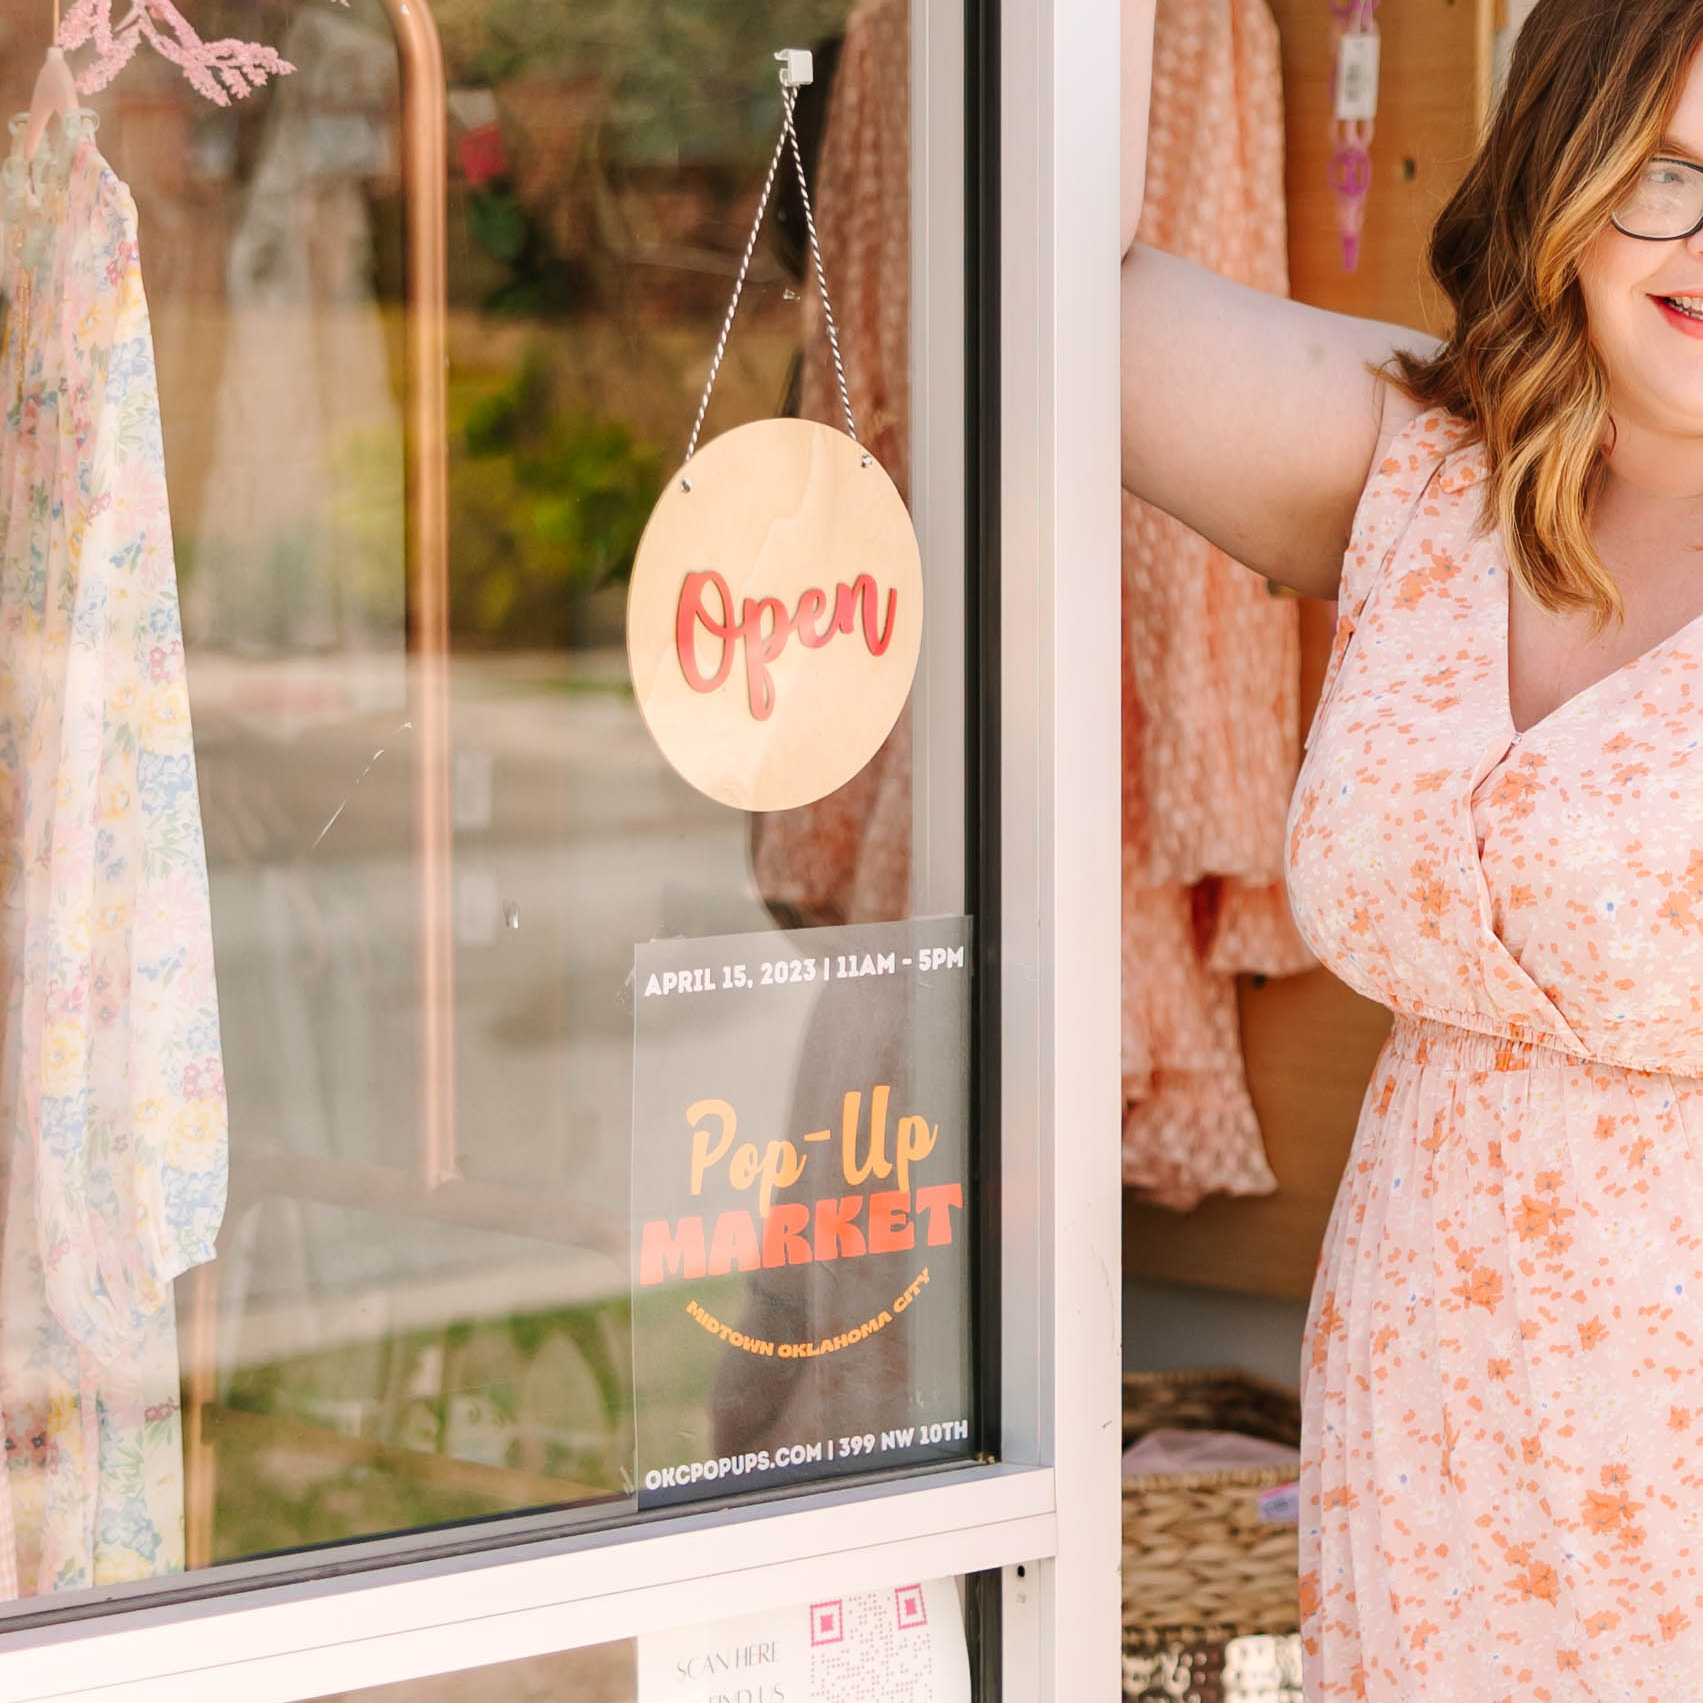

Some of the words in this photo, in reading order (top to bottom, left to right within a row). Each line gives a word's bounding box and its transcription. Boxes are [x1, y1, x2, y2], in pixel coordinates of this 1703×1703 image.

[675, 570, 898, 722] Open
[643, 967, 716, 997] APRIL
[722, 964, 754, 989] 15,
[760, 957, 817, 985] 2023
[836, 952, 896, 979] 11AM
[918, 946, 965, 971] 5PM
[685, 1084, 939, 1219] Pop-Up
[639, 1183, 963, 1286] MARKET
[685, 1299, 774, 1357] MIDTOWN
[777, 1310, 893, 1358] OKLAHOMA
[892, 1267, 931, 1314] CITY
[645, 1441, 822, 1491] OKCPOPUPS.COM
[838, 1433, 876, 1458] 399
[881, 1427, 915, 1452] NW
[919, 1419, 969, 1446] 10TH
[676, 1652, 729, 1681] SCAN
[735, 1641, 781, 1668] HERE
